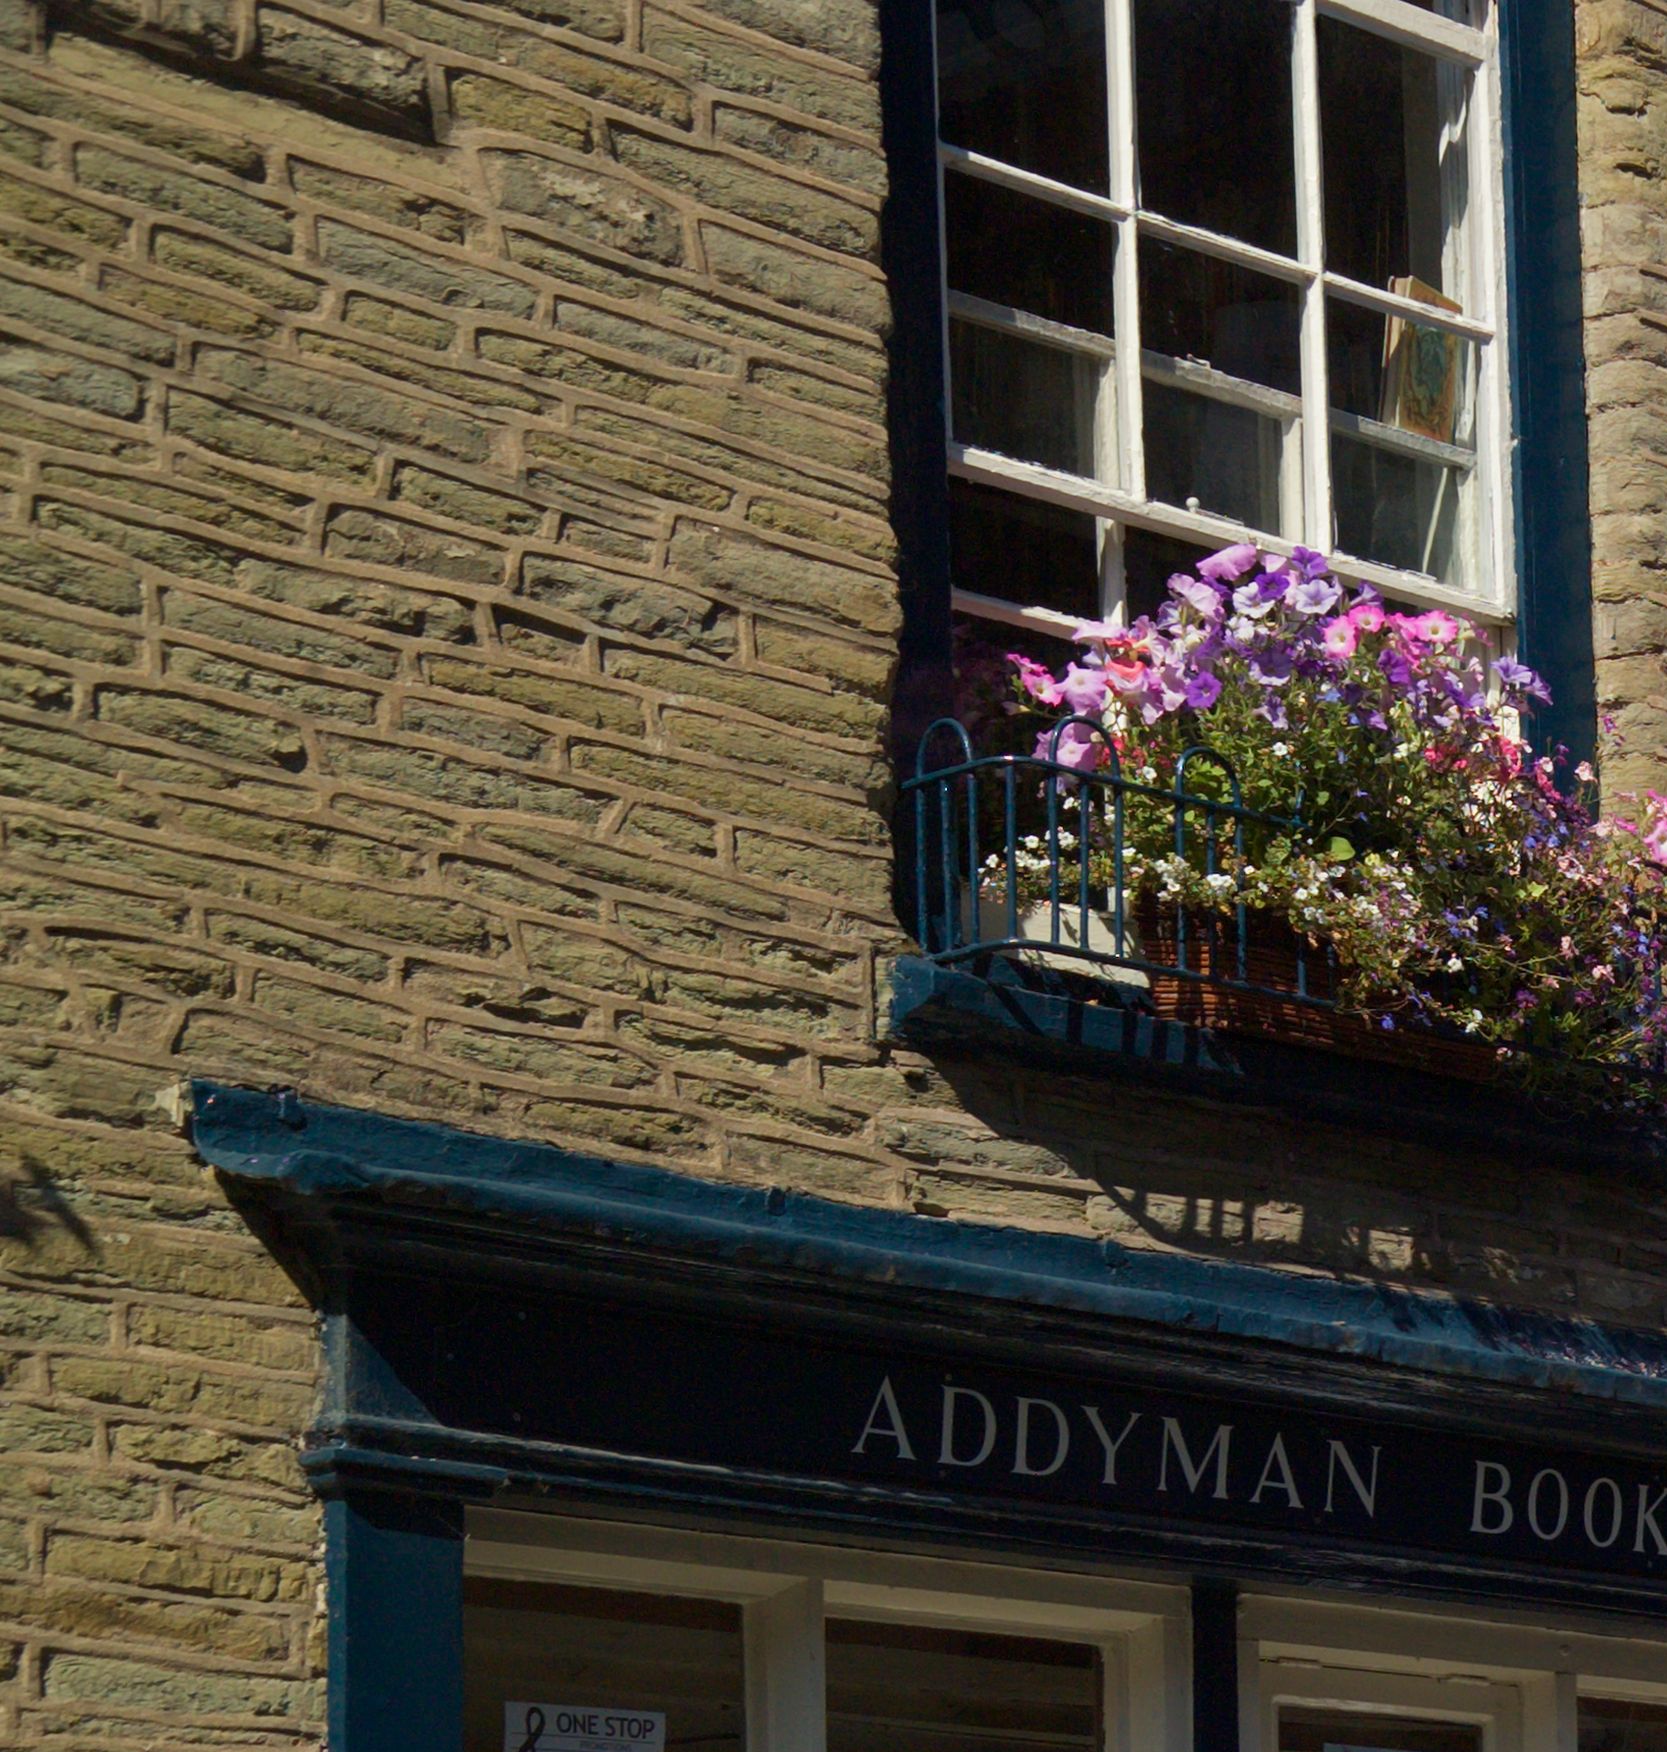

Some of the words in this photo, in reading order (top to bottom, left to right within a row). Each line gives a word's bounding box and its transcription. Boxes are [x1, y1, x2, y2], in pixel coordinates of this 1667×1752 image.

[850, 1374, 1384, 1519] ADDYMAN
[556, 1712, 598, 1735] ONE
[604, 1716, 655, 1740] STOP
